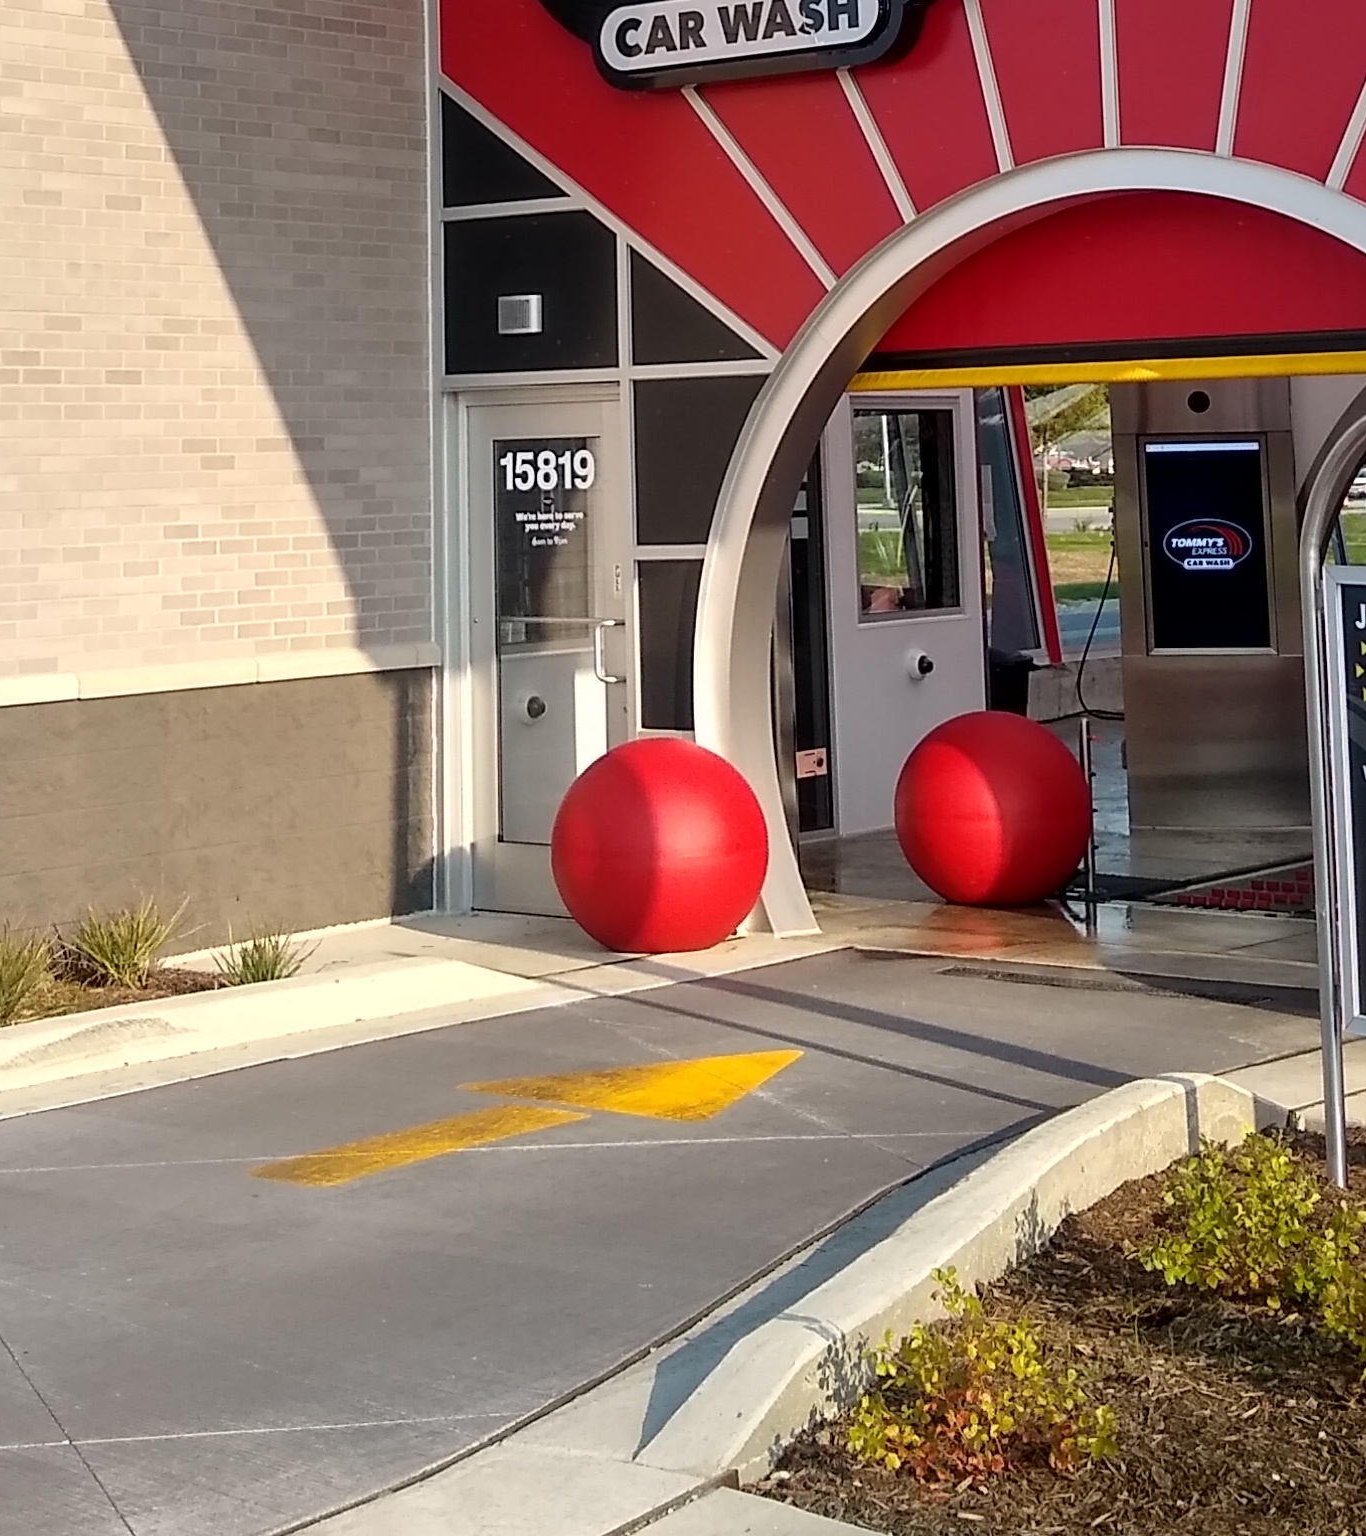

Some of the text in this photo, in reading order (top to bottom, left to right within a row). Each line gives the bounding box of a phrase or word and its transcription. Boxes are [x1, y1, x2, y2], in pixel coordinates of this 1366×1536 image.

[615, 10, 705, 57] CAR
[500, 450, 595, 490] 15819
[1171, 538, 1224, 548] TOMMY'S
[1192, 547, 1227, 555] EXPRESS
